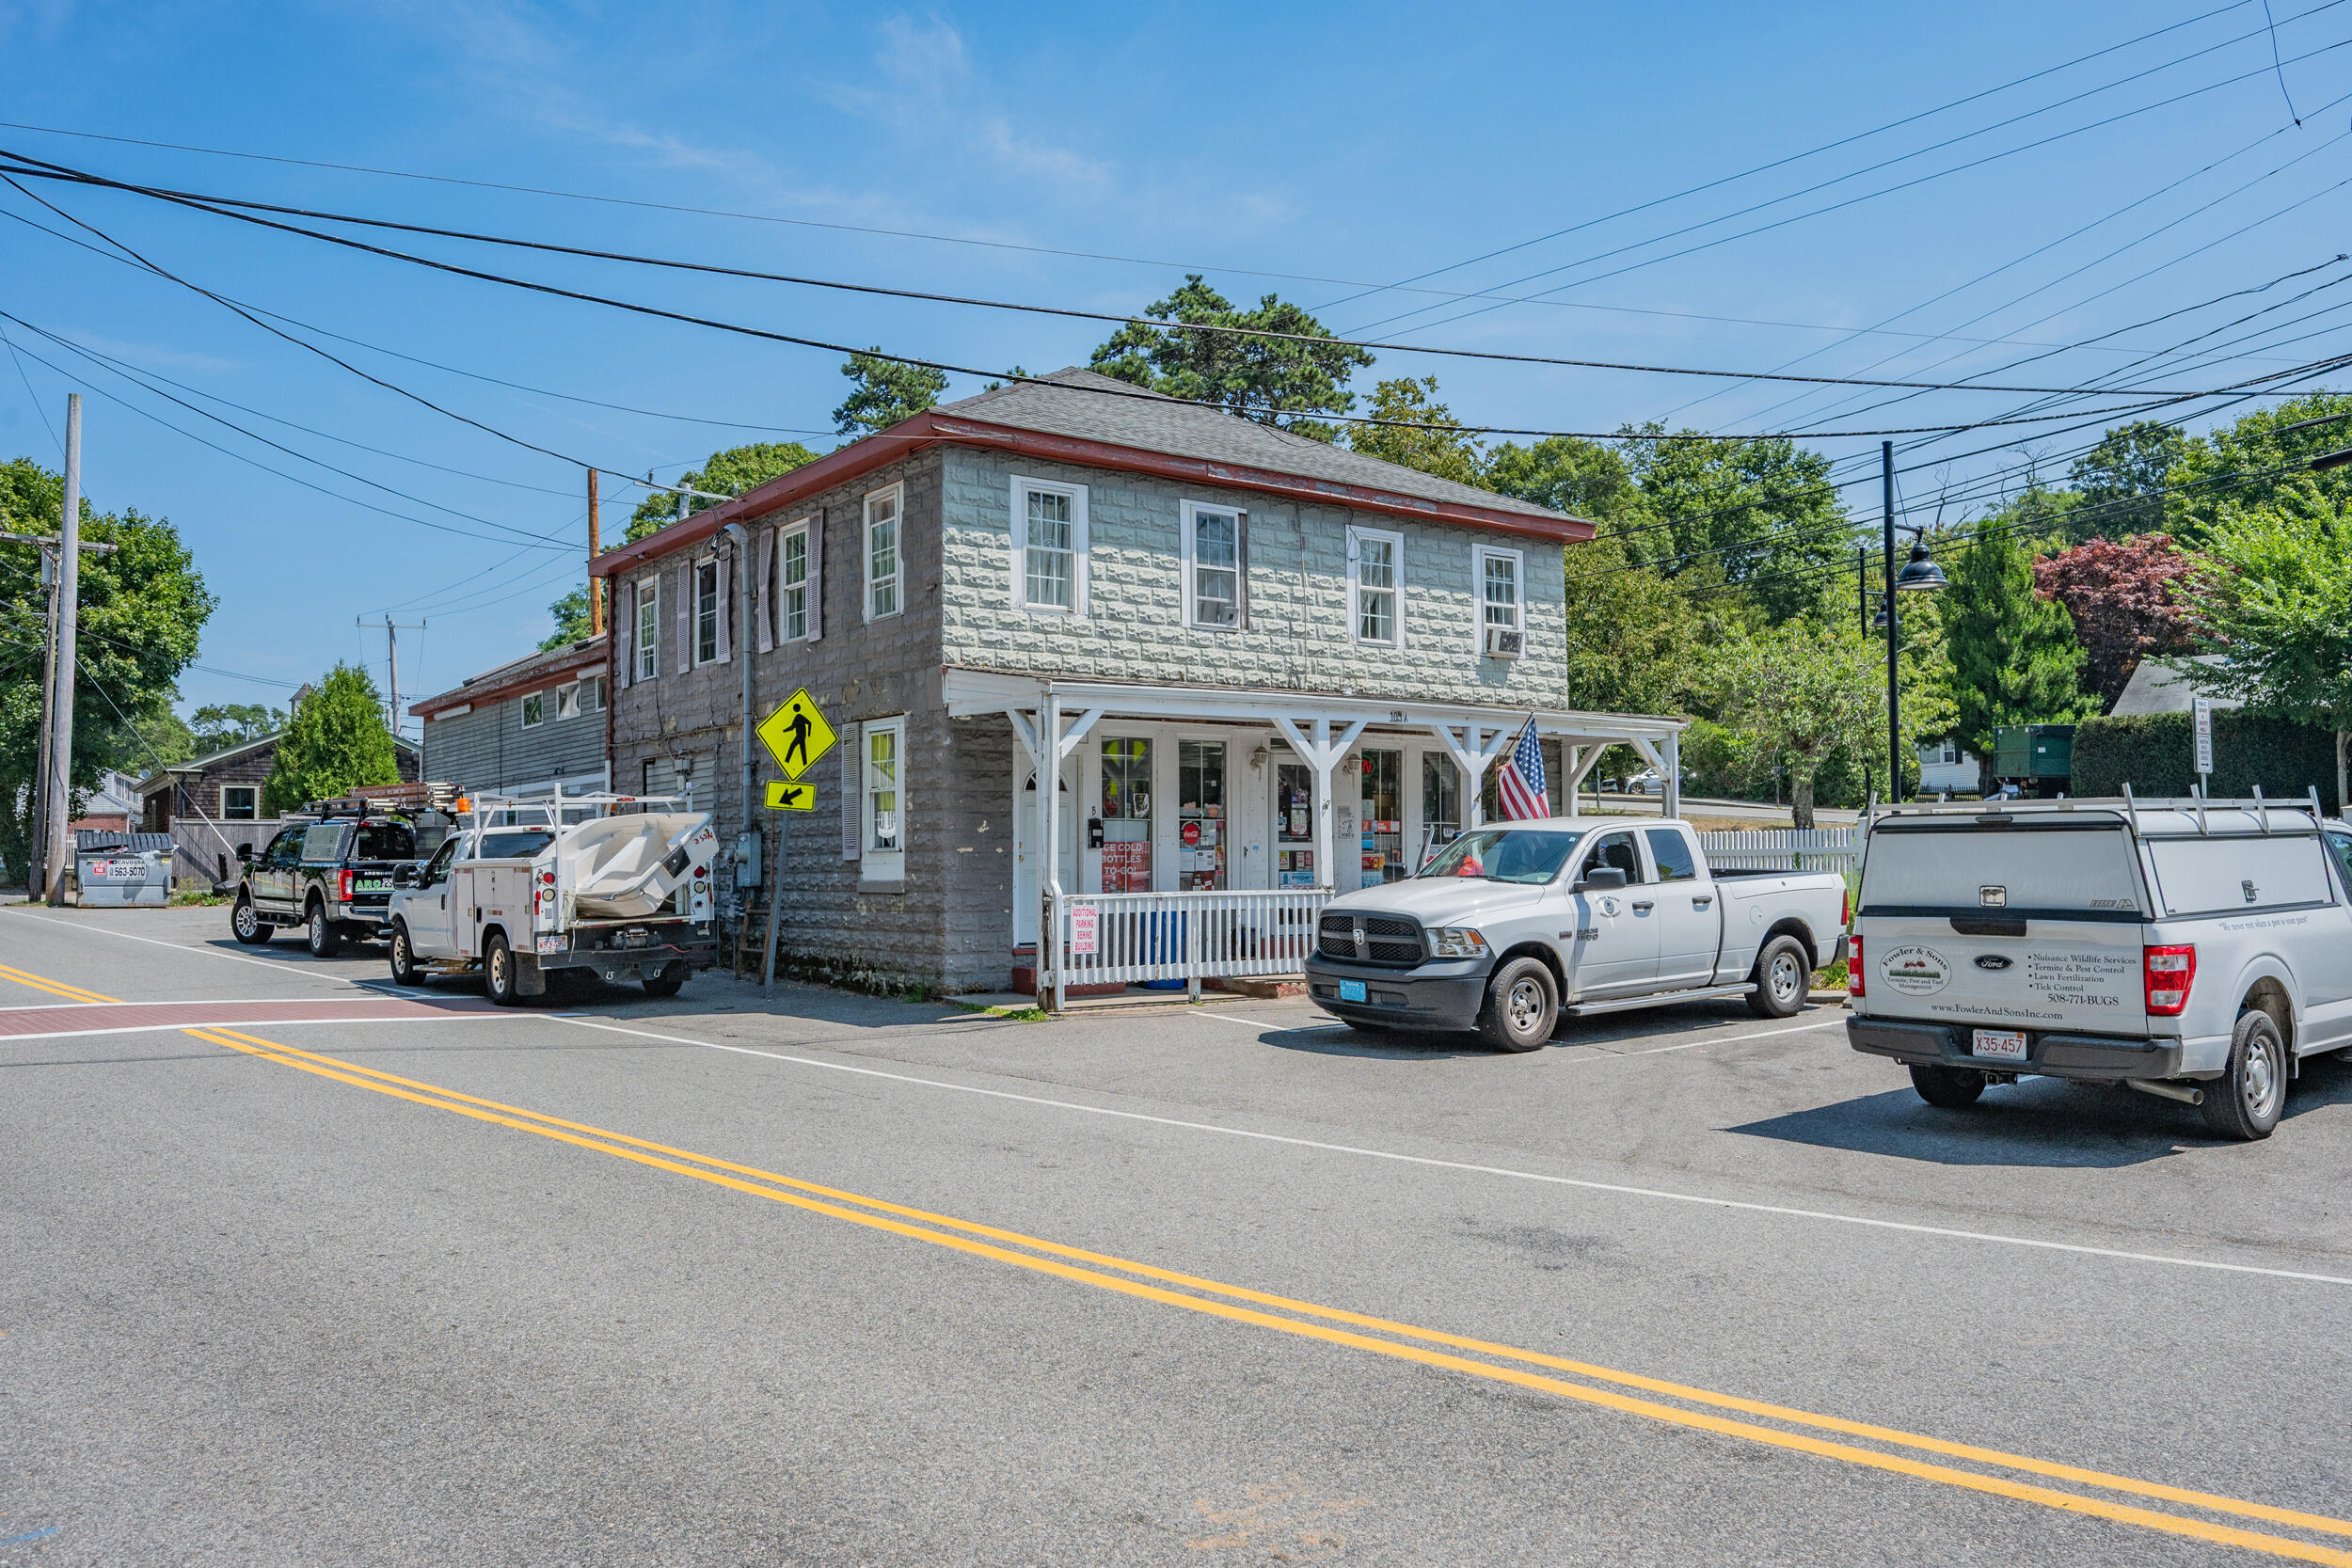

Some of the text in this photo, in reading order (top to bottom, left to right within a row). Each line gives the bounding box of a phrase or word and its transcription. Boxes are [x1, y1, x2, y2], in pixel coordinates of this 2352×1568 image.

[1118, 843, 1143, 852] COLD
[1102, 855, 1142, 863] BOTTLES
[114, 866, 146, 877] 563-5070
[1073, 908, 1097, 917] ADDITIONAL
[1075, 919, 1094, 928] PARKING
[1077, 930, 1092, 940] BEHIND
[1075, 942, 1094, 951] BUILDING
[1883, 948, 1915, 967] Fowler
[1926, 950, 1948, 971] Sons
[1981, 959, 2004, 969] Ford
[2033, 953, 2137, 965] Nuisance Wildlife Services
[2033, 962, 2063, 972] Termite
[2075, 964, 2090, 973] Pest
[2093, 965, 2125, 974] Control
[2033, 973, 2105, 983] Lawn Fertilization
[2034, 982, 2084, 992] Tick Control
[2047, 993, 2120, 1006] 508-771-BUGS
[1931, 1004, 2063, 1020] www.FowlerAndSonsInc.com
